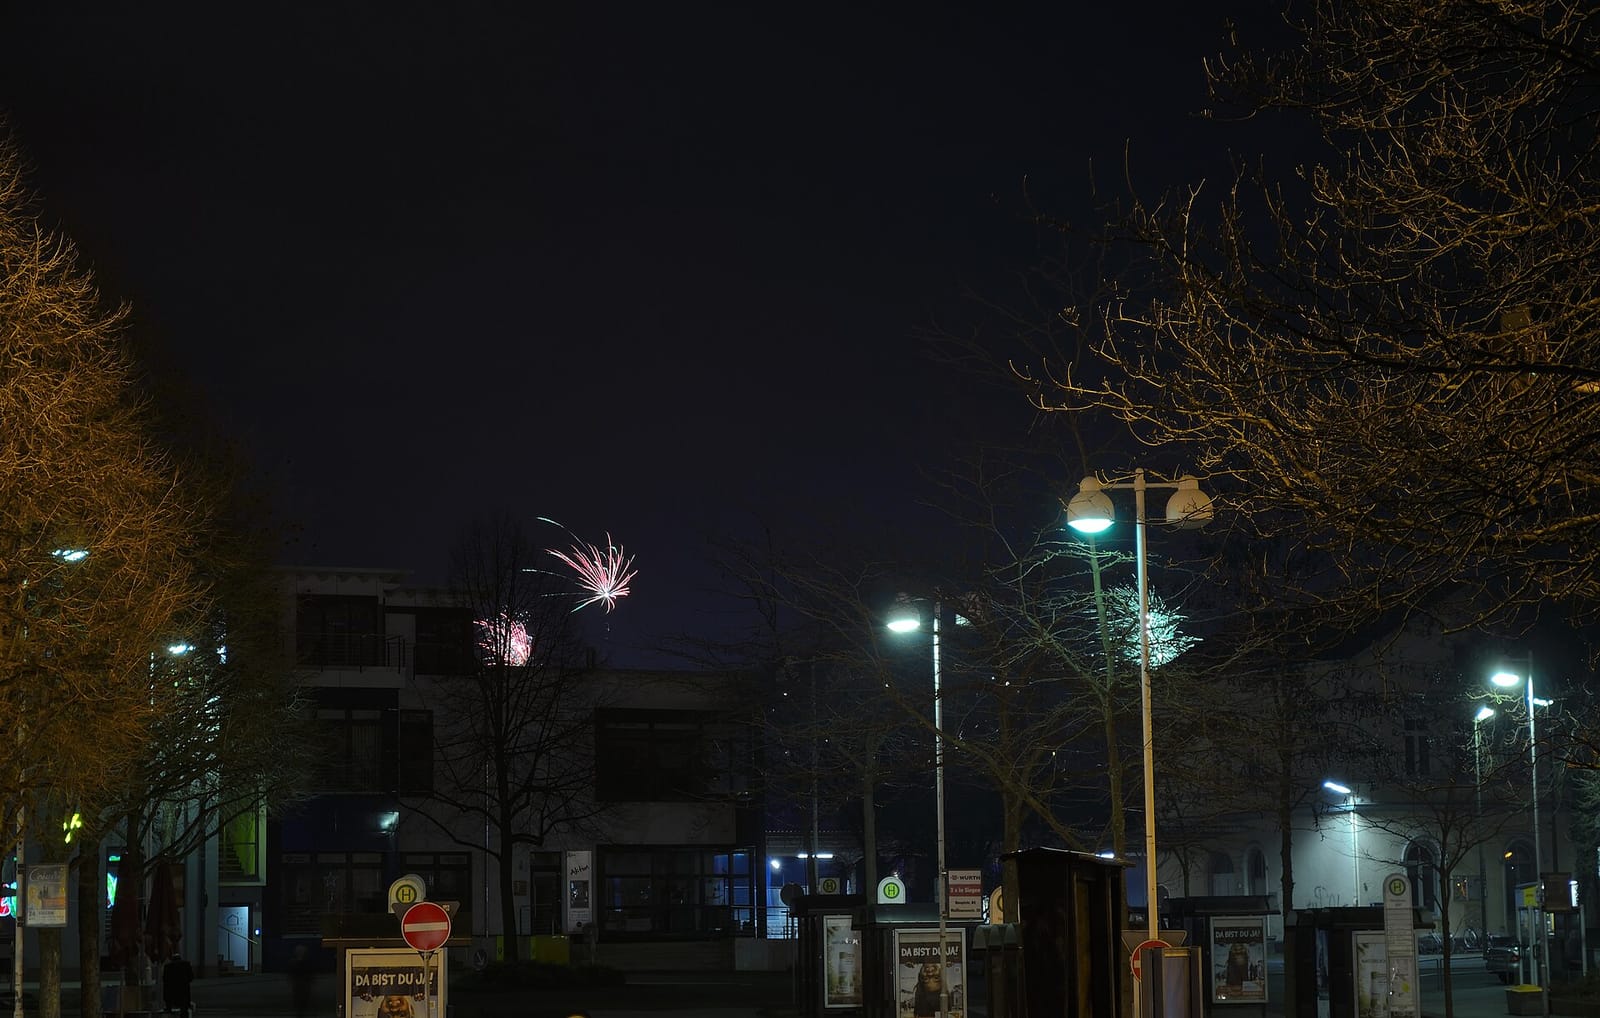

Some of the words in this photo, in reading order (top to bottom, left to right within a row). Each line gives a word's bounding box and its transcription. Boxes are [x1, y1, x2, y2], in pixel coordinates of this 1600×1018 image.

[401, 889, 411, 901] H
[901, 947, 912, 957] DA
[913, 947, 931, 956] BIST
[945, 945, 959, 956] JA!
[355, 974, 370, 986] DA
[372, 973, 396, 986] BIST
[398, 973, 414, 985] DU
